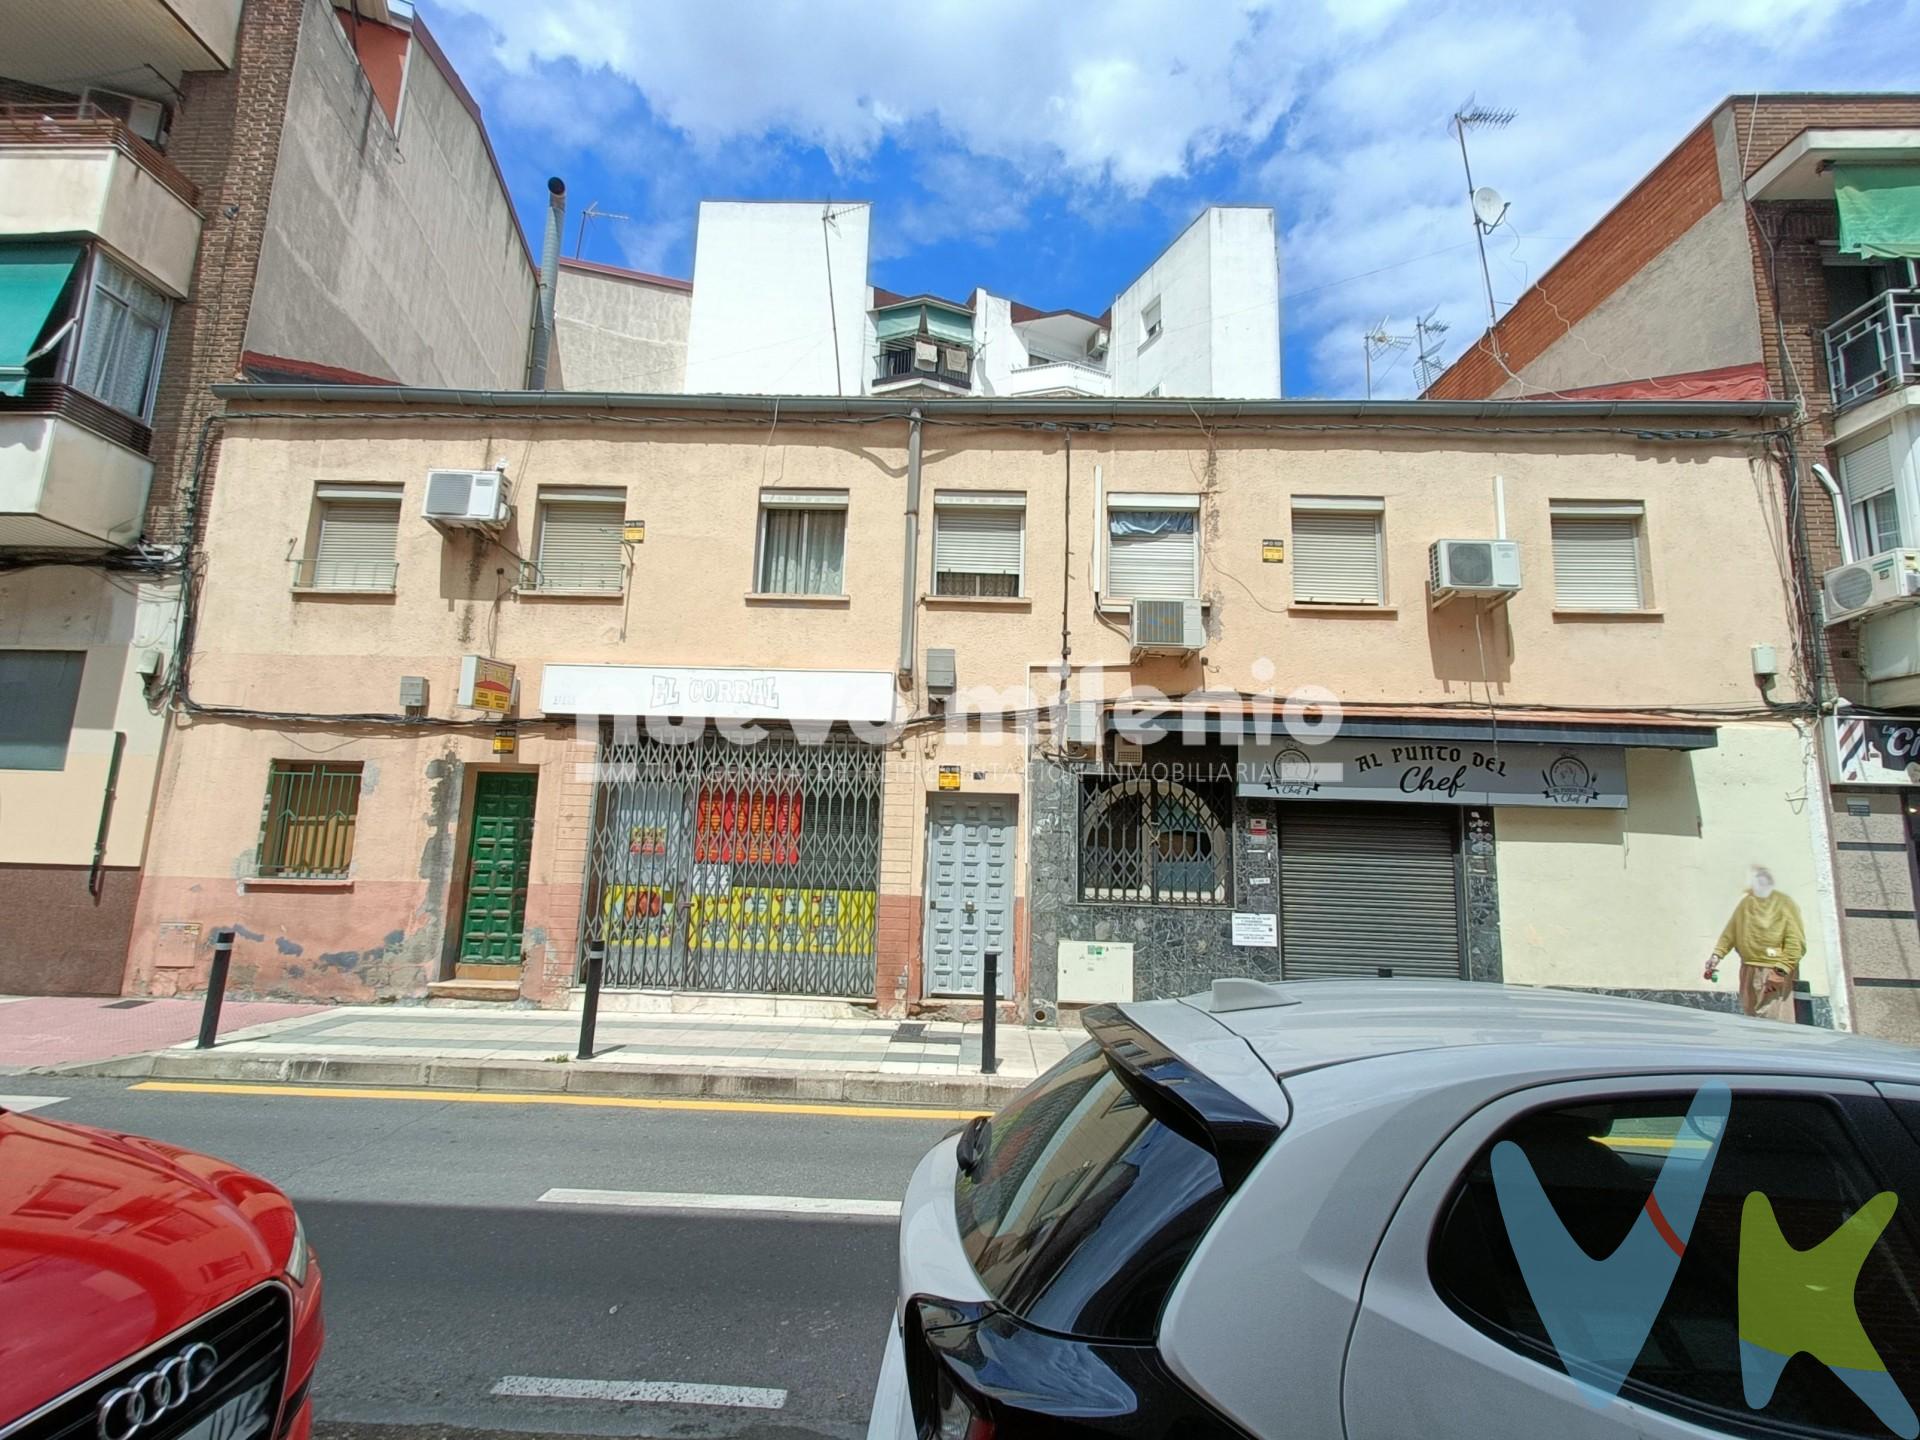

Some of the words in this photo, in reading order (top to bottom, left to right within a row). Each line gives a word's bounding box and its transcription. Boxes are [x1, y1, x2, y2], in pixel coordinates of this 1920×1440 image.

[650, 675, 680, 709] EL
[689, 676, 779, 709] CORRAL
[1355, 753, 1383, 773] AL
[1391, 745, 1462, 763] PUNTO
[1472, 752, 1507, 777] DEL
[1400, 765, 1467, 798] Chef
